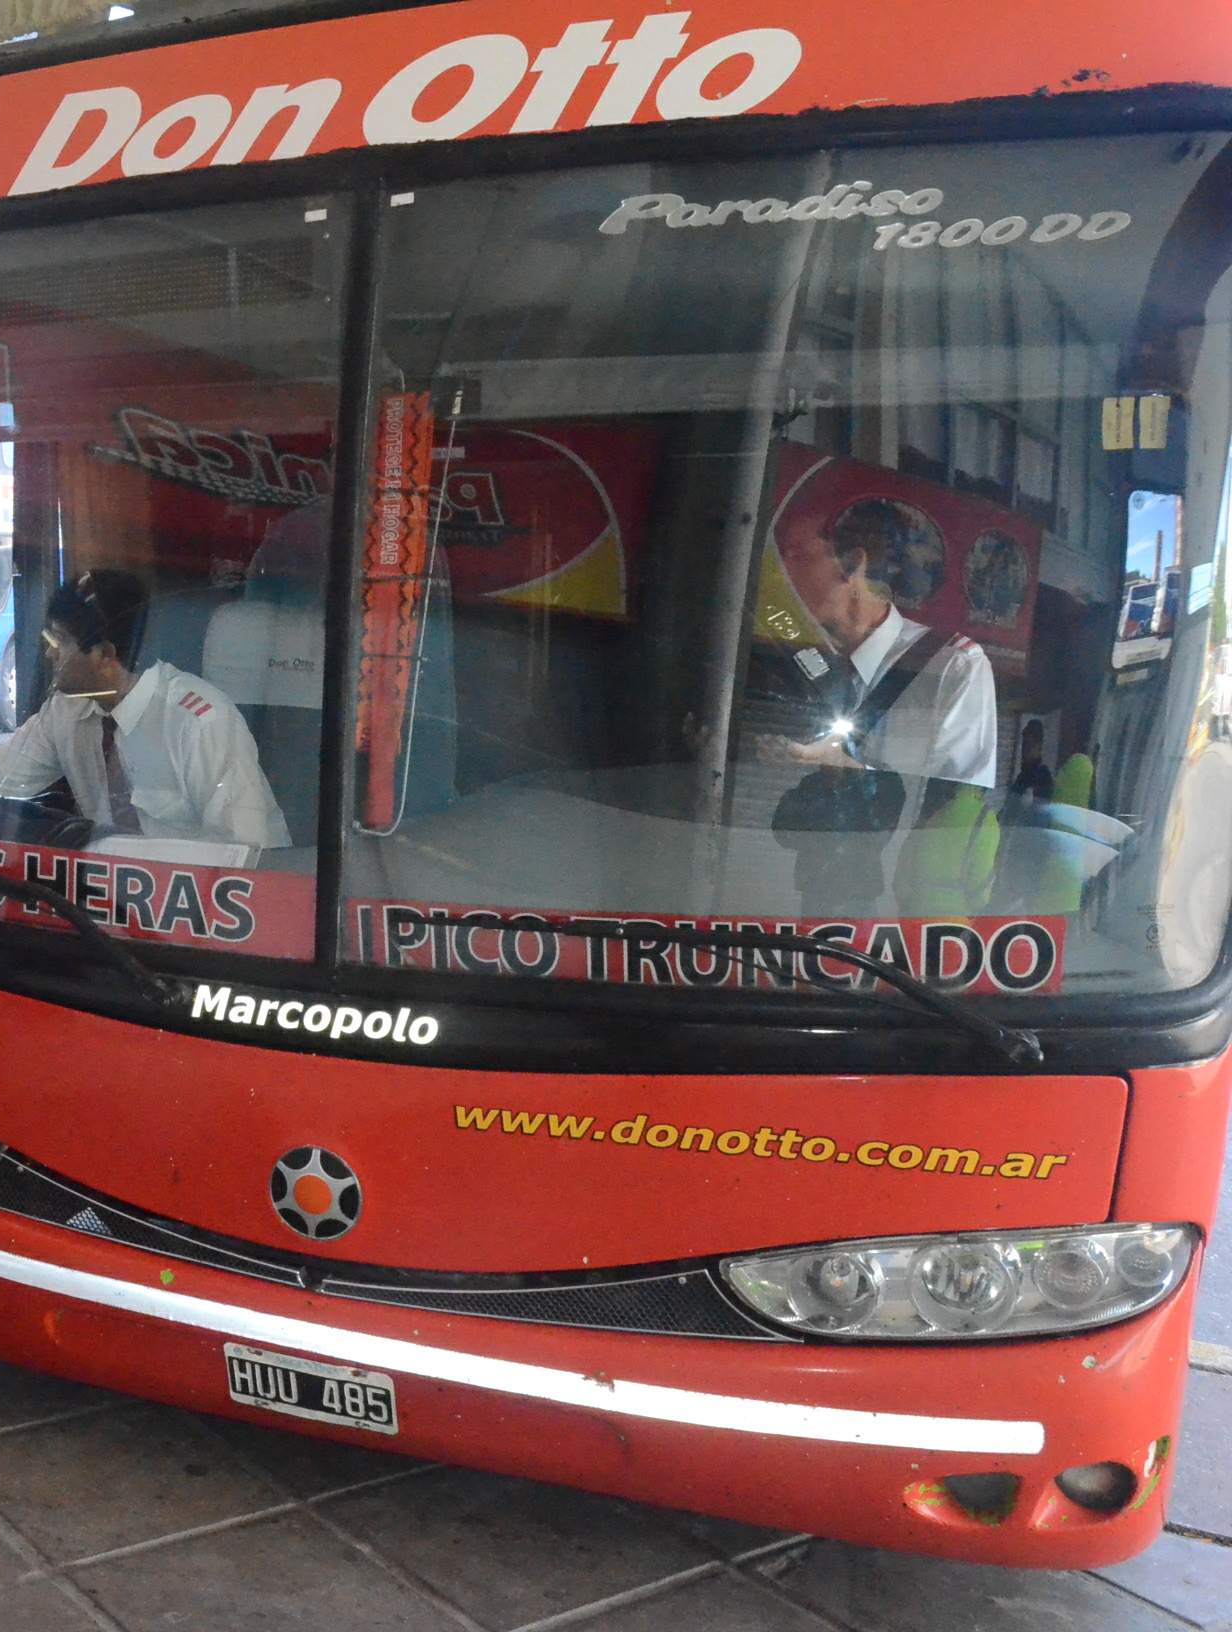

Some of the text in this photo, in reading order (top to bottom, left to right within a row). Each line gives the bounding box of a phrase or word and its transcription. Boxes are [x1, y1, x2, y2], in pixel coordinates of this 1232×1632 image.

[8, 10, 803, 197] Don Otto
[598, 180, 945, 235] Paradiso
[380, 504, 401, 566] HOGAR
[23, 851, 256, 943] HERAS
[571, 915, 1058, 992] TRUNCADO
[191, 984, 439, 1045] Marcopolo
[453, 1103, 1068, 1181] www.donotto.com.ar
[232, 1358, 299, 1404] HUU
[322, 1379, 389, 1423] 485
